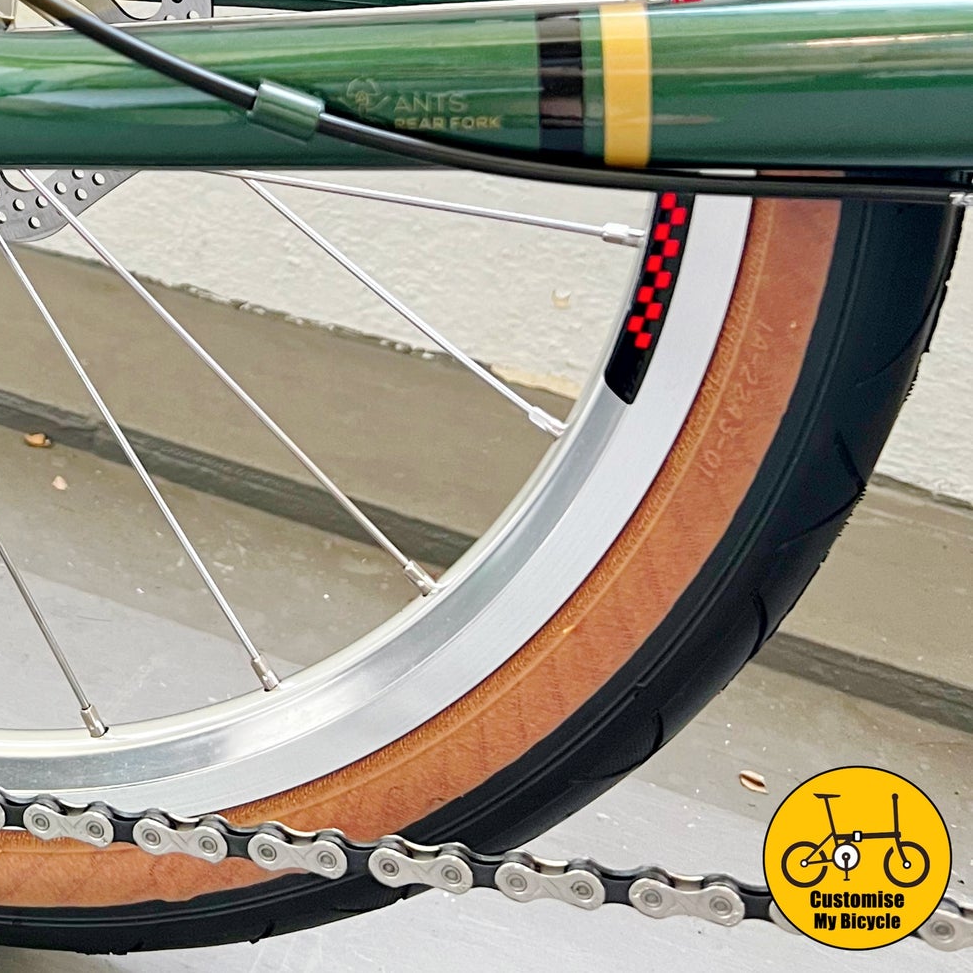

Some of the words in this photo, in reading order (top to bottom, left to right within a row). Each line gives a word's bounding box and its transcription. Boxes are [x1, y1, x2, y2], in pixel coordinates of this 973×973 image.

[395, 93, 467, 112] ANTS
[396, 118, 446, 129] REAR
[450, 116, 501, 129] FORK
